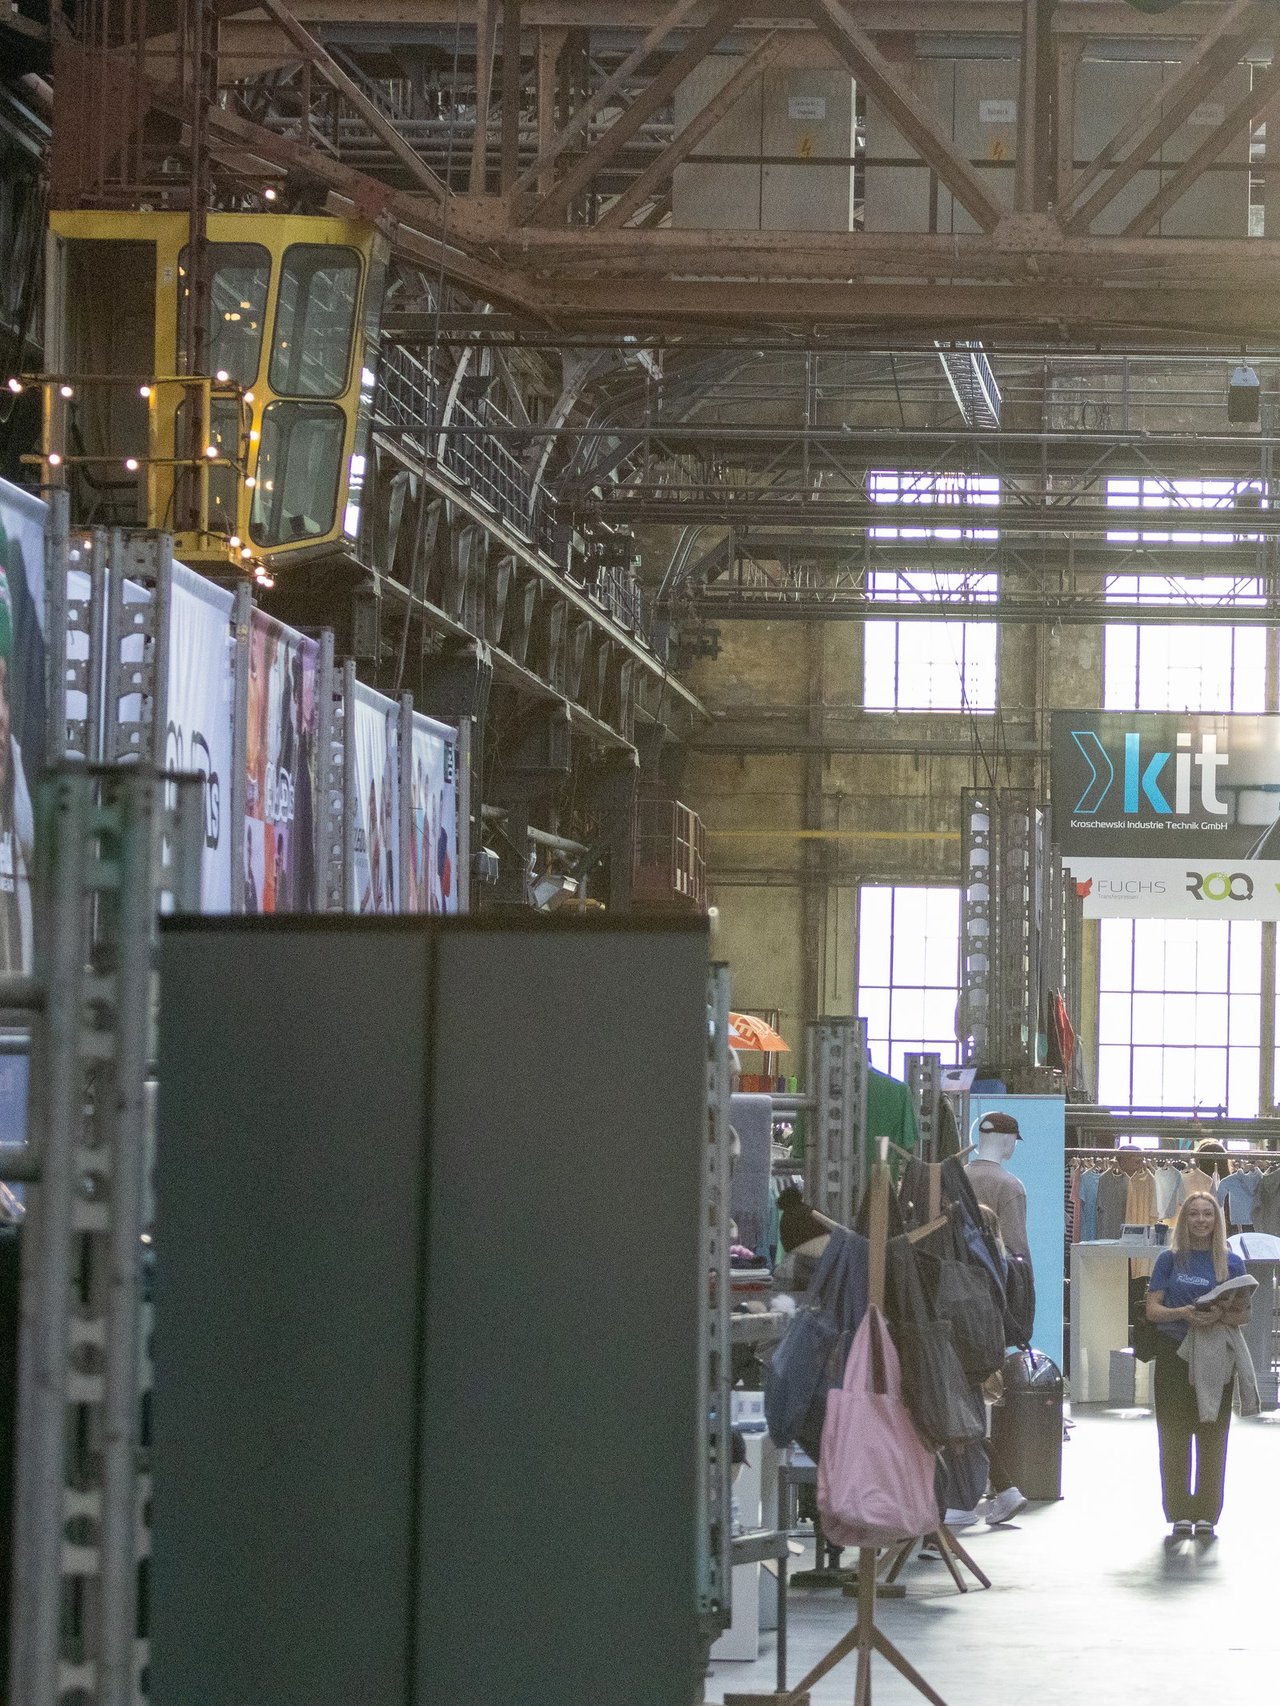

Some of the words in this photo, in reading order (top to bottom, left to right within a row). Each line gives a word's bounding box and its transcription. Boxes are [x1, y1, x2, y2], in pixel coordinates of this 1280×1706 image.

[1123, 732, 1229, 815] kit
[1070, 819, 1126, 829] Kroschewski
[1127, 820, 1164, 829] Industrie
[1165, 821, 1200, 830] Technik
[1201, 821, 1228, 830] GmbH
[1098, 880, 1166, 893] FUCHS
[1185, 871, 1255, 901] ROQ
